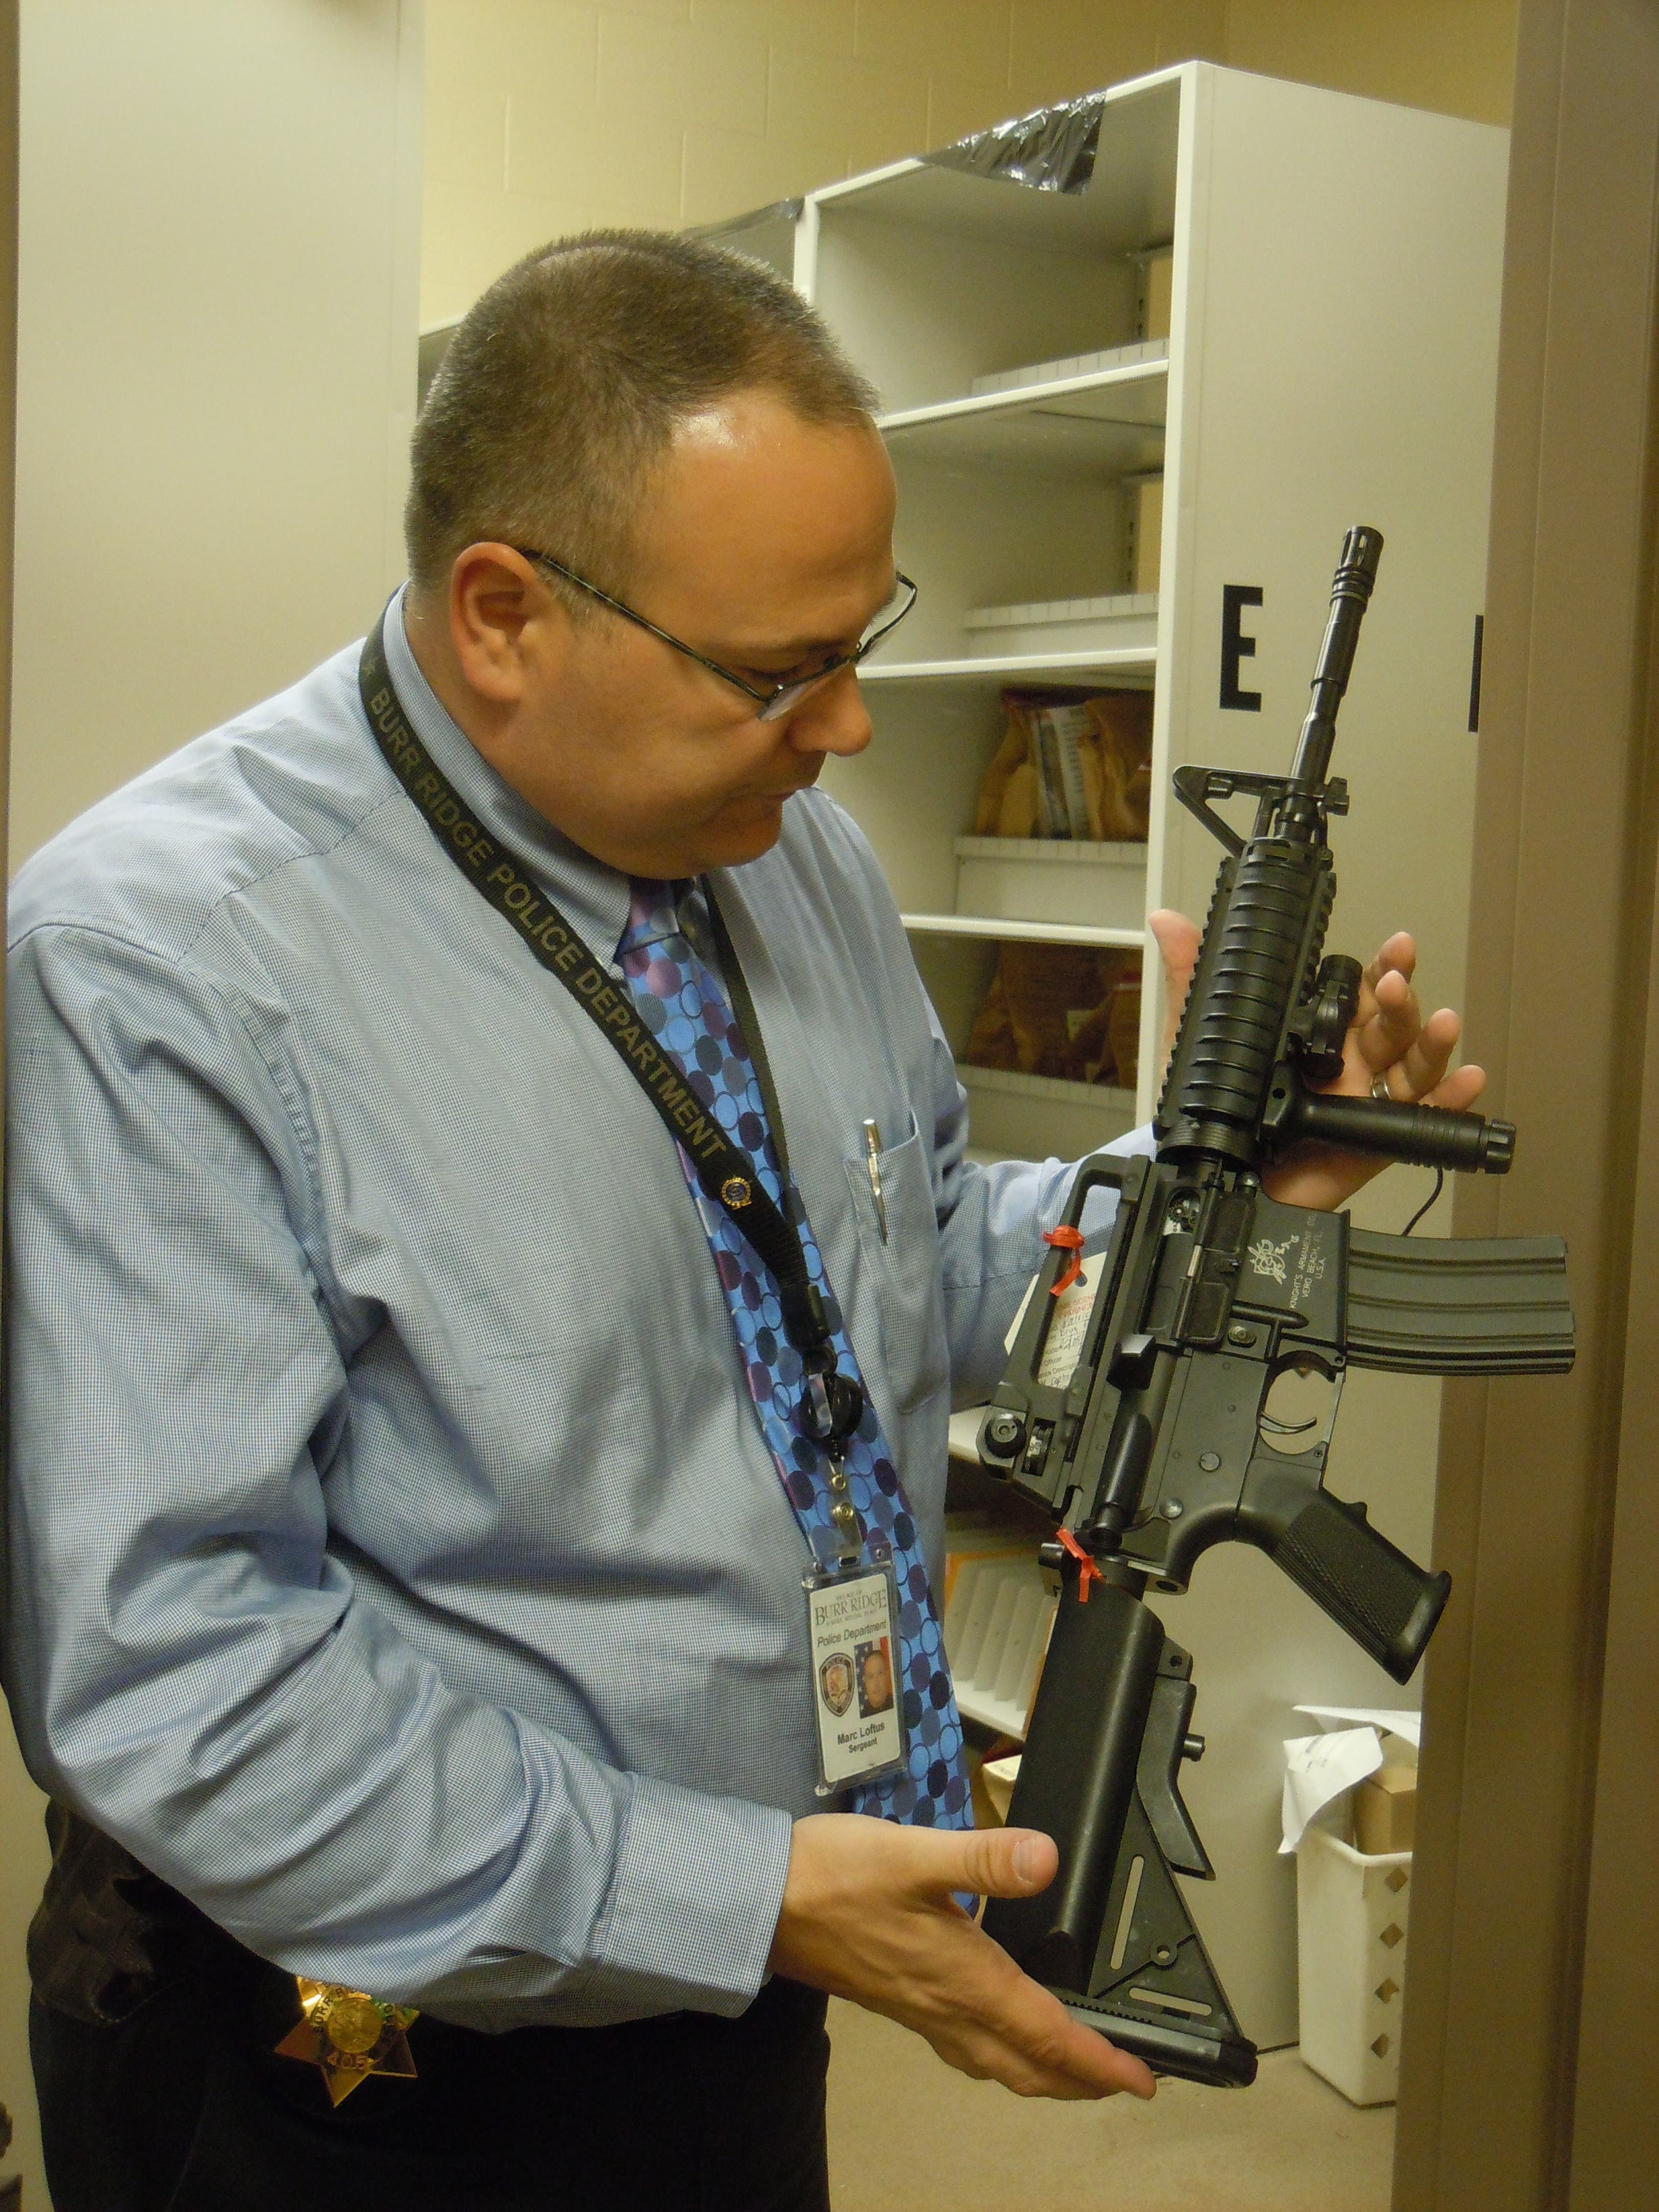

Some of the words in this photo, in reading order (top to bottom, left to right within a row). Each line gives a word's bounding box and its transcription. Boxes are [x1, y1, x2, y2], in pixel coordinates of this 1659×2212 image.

[1220, 585, 1263, 712] E
[370, 688, 421, 773] BURR
[416, 772, 494, 867] RIDGE
[487, 863, 584, 971] POLICE
[576, 967, 727, 1159] DEPARTMENT
[1289, 1273, 1304, 1309] KNIGHT'S
[1298, 1231, 1312, 1270] ARMAMENT
[1302, 1277, 1312, 1298] VERO
[815, 1601, 848, 1626] BURR
[850, 1589, 887, 1611] RIDGE
[818, 1633, 841, 1648] Police
[843, 1619, 887, 1640] Department
[837, 1732, 858, 1746] Marc
[859, 1722, 885, 1738] Loftus
[848, 1736, 878, 1753] Sergeant
